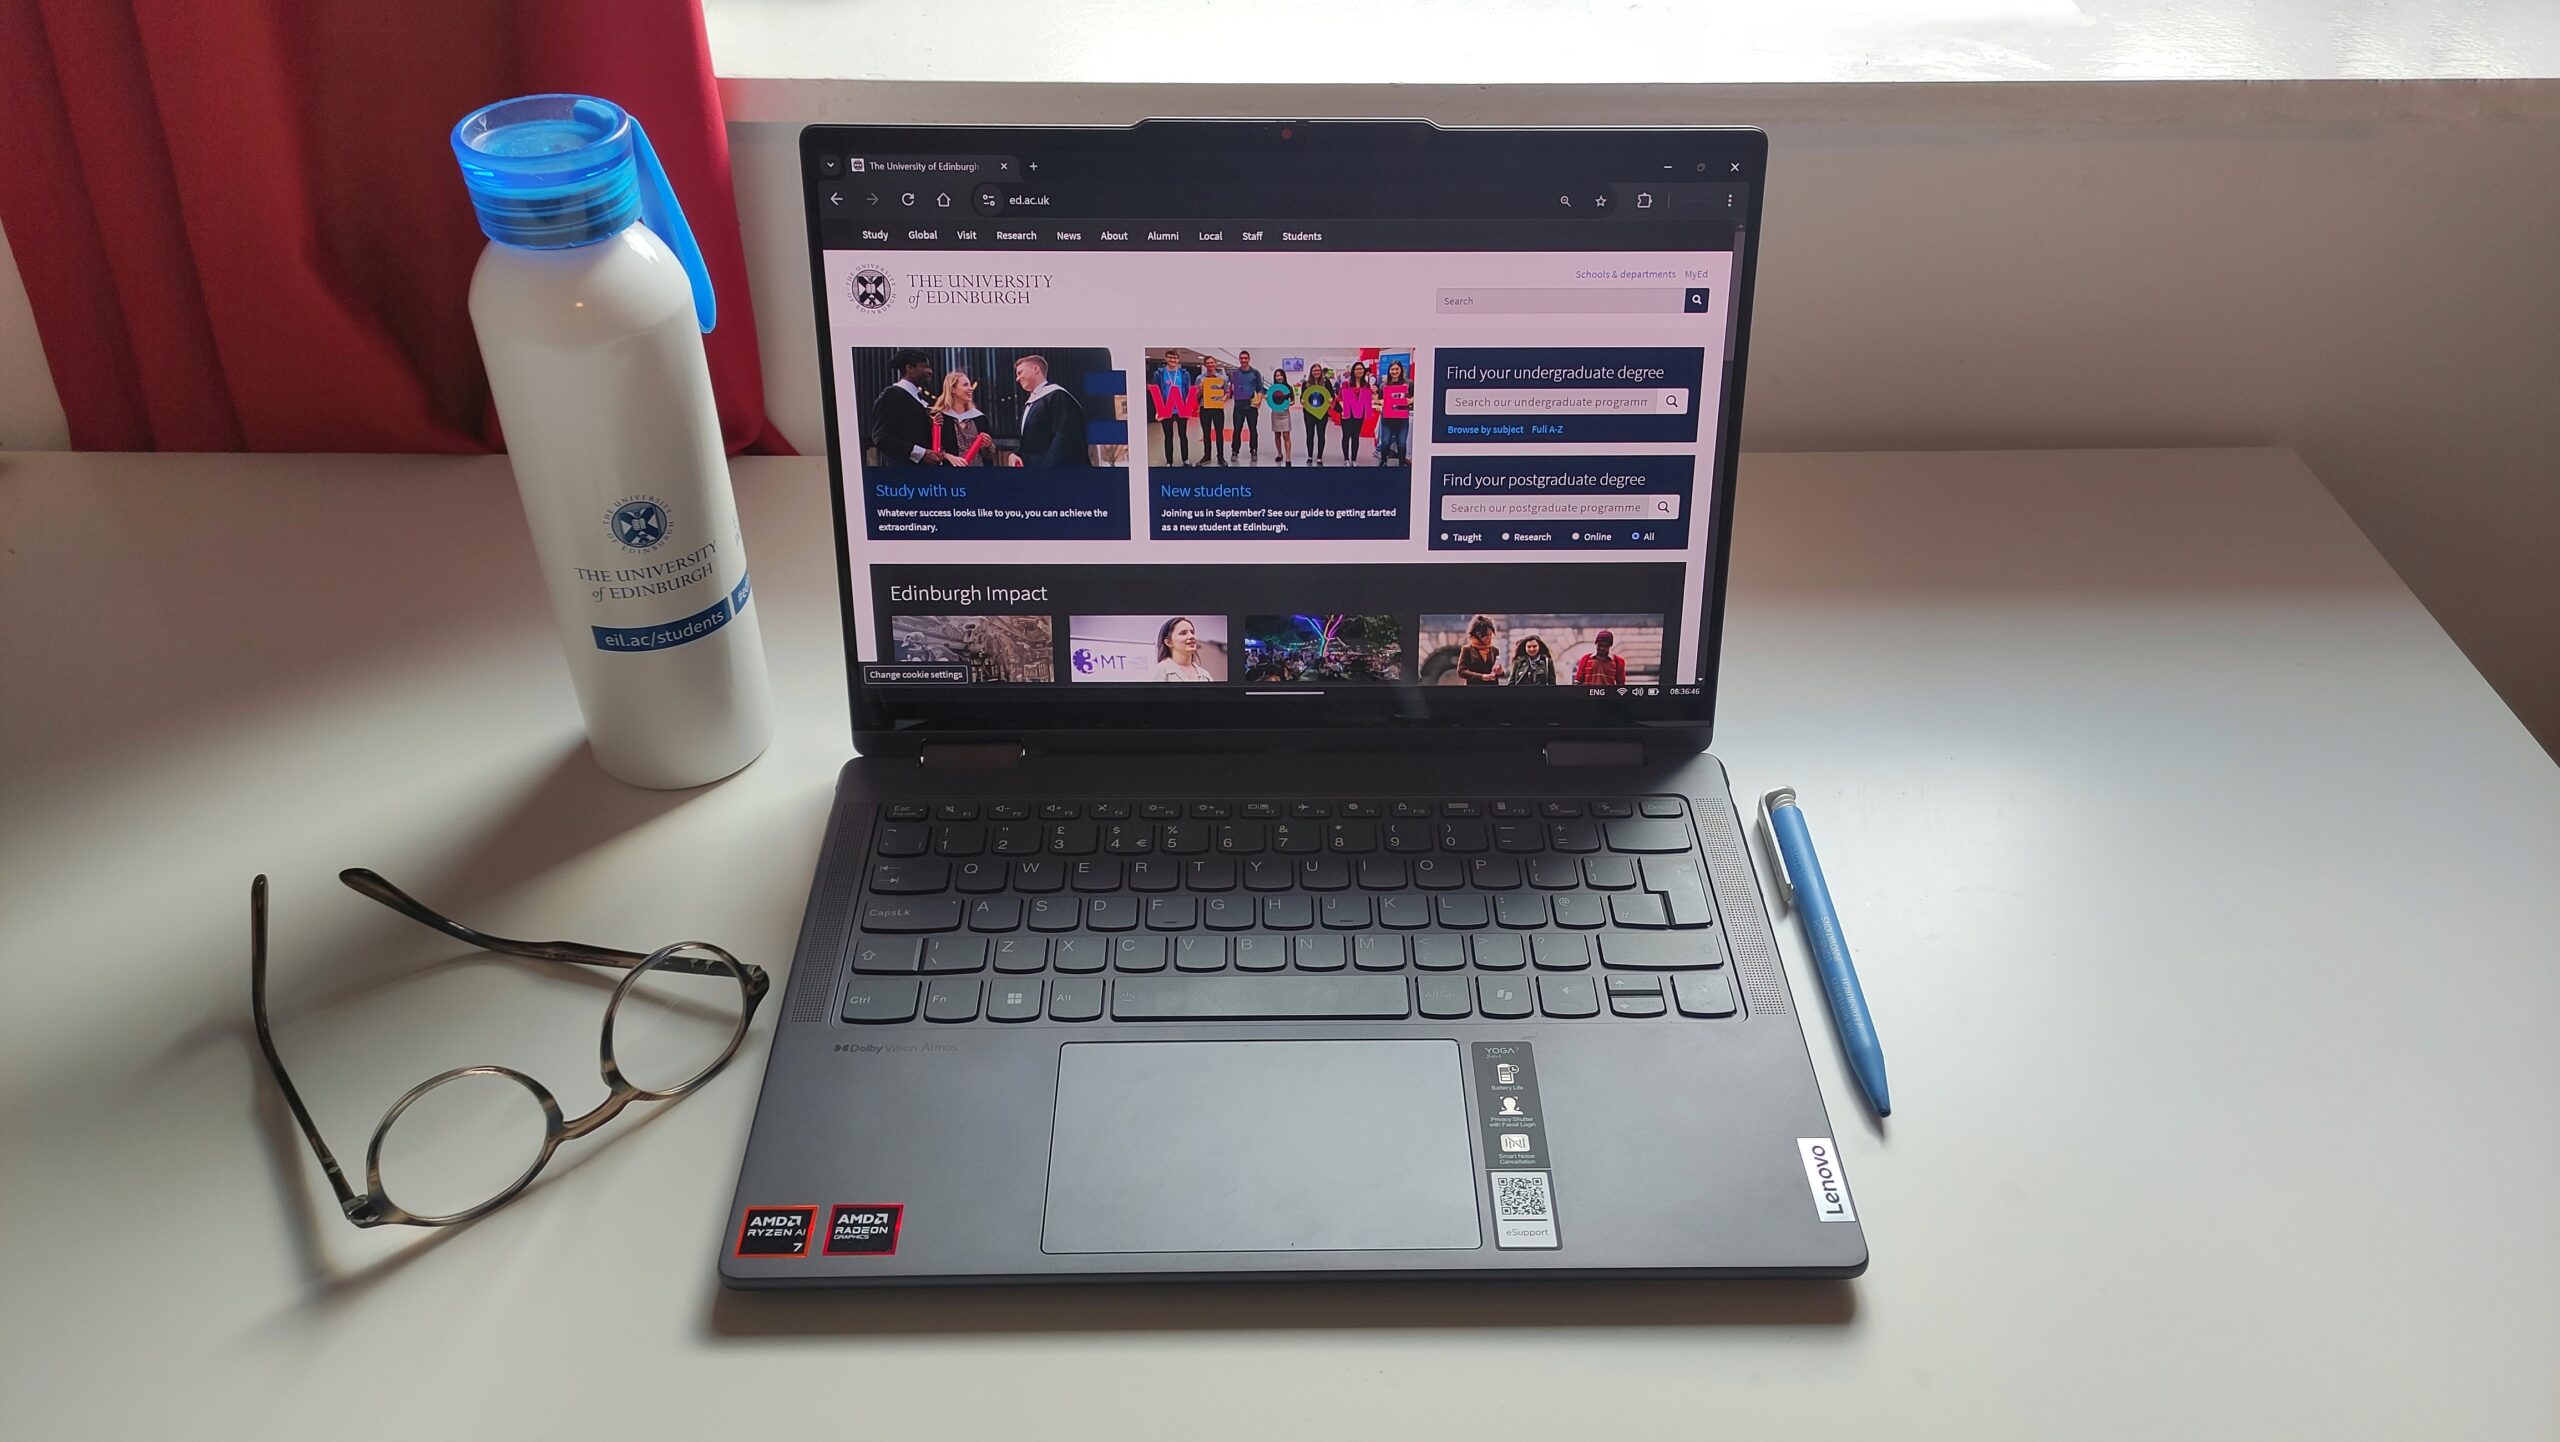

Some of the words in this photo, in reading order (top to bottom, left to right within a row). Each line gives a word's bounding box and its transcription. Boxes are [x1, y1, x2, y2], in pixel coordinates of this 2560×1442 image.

[870, 161, 884, 171] The
[887, 161, 925, 173] University
[928, 161, 937, 171] of
[939, 161, 980, 173] Edinburgh
[1009, 195, 1050, 206] ed.ac.uk
[862, 230, 888, 242] Study
[908, 230, 938, 240] Global
[957, 230, 977, 240] Visit
[996, 231, 1037, 241] Research
[1057, 231, 1081, 241] News
[1100, 231, 1128, 241] About
[1147, 231, 1179, 241] Alumni
[1199, 231, 1223, 241] Local
[1242, 231, 1263, 241] Staff
[1282, 231, 1322, 241] Students
[1575, 269, 1609, 279] Schools
[1611, 270, 1618, 279] &
[1620, 269, 1676, 281] departments
[1684, 269, 1708, 281] MyEd
[907, 274, 943, 289] THE
[948, 274, 1054, 289] UNIVERSITY
[908, 291, 922, 309] of
[927, 290, 1030, 304] EDINBURGH
[1444, 296, 1473, 306] Search
[1446, 366, 1476, 380] Find
[1479, 369, 1510, 382] your
[1514, 366, 1614, 382] undergraduate
[1618, 366, 1664, 382] degree
[1455, 397, 1491, 407] Search
[1494, 399, 1512, 407] our
[1515, 397, 1591, 410] undergraduate
[1448, 425, 1479, 434] Browse
[1480, 424, 1490, 436] by
[1492, 424, 1524, 436] subject
[1532, 424, 1547, 434] Full
[1547, 424, 1563, 434] A-Z
[1442, 473, 1471, 487] Find
[1475, 476, 1505, 490] your
[1509, 473, 1597, 490] postgraduate
[1600, 473, 1646, 489] degree
[876, 484, 914, 500] Study
[918, 484, 946, 497] with
[949, 487, 966, 498] us
[1161, 484, 1190, 498] New
[1194, 484, 1252, 498] students
[877, 508, 917, 518] Whatever
[919, 510, 951, 518] success
[953, 508, 976, 518] looks
[978, 508, 992, 518] like
[994, 509, 1003, 518] to
[1005, 510, 1024, 520] you,
[1025, 510, 1040, 520] you
[1042, 510, 1057, 518] can
[1059, 508, 1091, 518] achieve
[1093, 508, 1108, 518] the
[1161, 508, 1193, 520] Joining
[1195, 510, 1204, 518] us
[1206, 508, 1213, 518] in
[1215, 508, 1265, 520] September?
[1267, 509, 1282, 518] See
[1284, 510, 1299, 518] our
[1301, 508, 1324, 520] guide
[1326, 508, 1334, 517] to
[1336, 508, 1366, 519] getting
[1368, 508, 1396, 517] started
[1451, 503, 1486, 513] Search
[1489, 505, 1506, 513] our
[1509, 502, 1577, 515] postgraduate
[1580, 505, 1641, 516] programme
[878, 522, 938, 534] extraordinary.
[1161, 524, 1171, 532] as
[1173, 524, 1178, 532] a
[1180, 524, 1197, 532] new
[1199, 522, 1231, 532] student
[1233, 523, 1242, 532] at
[1244, 522, 1288, 534] Edinburgh.
[1453, 532, 1482, 544] Taught
[1514, 532, 1551, 542] Research
[1584, 532, 1612, 541] Online
[1643, 532, 1655, 541] All
[574, 566, 611, 583] THE
[615, 540, 718, 582] UNIVERSITY
[592, 586, 605, 602] of
[610, 563, 713, 599] EDINBURGH
[890, 585, 981, 605] Edinburgh
[986, 585, 1048, 605] Impact
[605, 610, 724, 647] eil.ac/students
[1101, 654, 1126, 670] MT
[870, 670, 899, 682] Change
[902, 670, 928, 679] cookie
[930, 670, 963, 682] settings
[1589, 688, 1605, 696] ENG
[964, 864, 978, 874] Q
[1022, 863, 1040, 873] W
[1079, 863, 1090, 873] E
[1135, 862, 1147, 872] R
[1194, 862, 1204, 871] T
[1251, 862, 1263, 871] Y
[1306, 861, 1317, 871] U
[1420, 860, 1433, 870] O
[1476, 860, 1487, 870] P
[977, 901, 989, 911] A
[1036, 901, 1047, 911] S
[1095, 901, 1106, 911] D
[1152, 900, 1163, 910] F
[1211, 899, 1225, 909] G
[1269, 899, 1281, 909] H
[1327, 899, 1336, 909] J
[1384, 898, 1396, 908] K
[1443, 898, 1452, 908] L
[869, 908, 911, 918] CapsLk
[850, 996, 871, 1004] Ctrl
[933, 995, 946, 1003] Fn
[851, 1044, 882, 1054] Dolby
[1812, 1145, 1844, 1214] Lenovo
[750, 1216, 787, 1226] AMD
[837, 1214, 874, 1224] AMD
[1507, 1228, 1549, 1237] eSupport
[793, 1243, 802, 1252] 7
